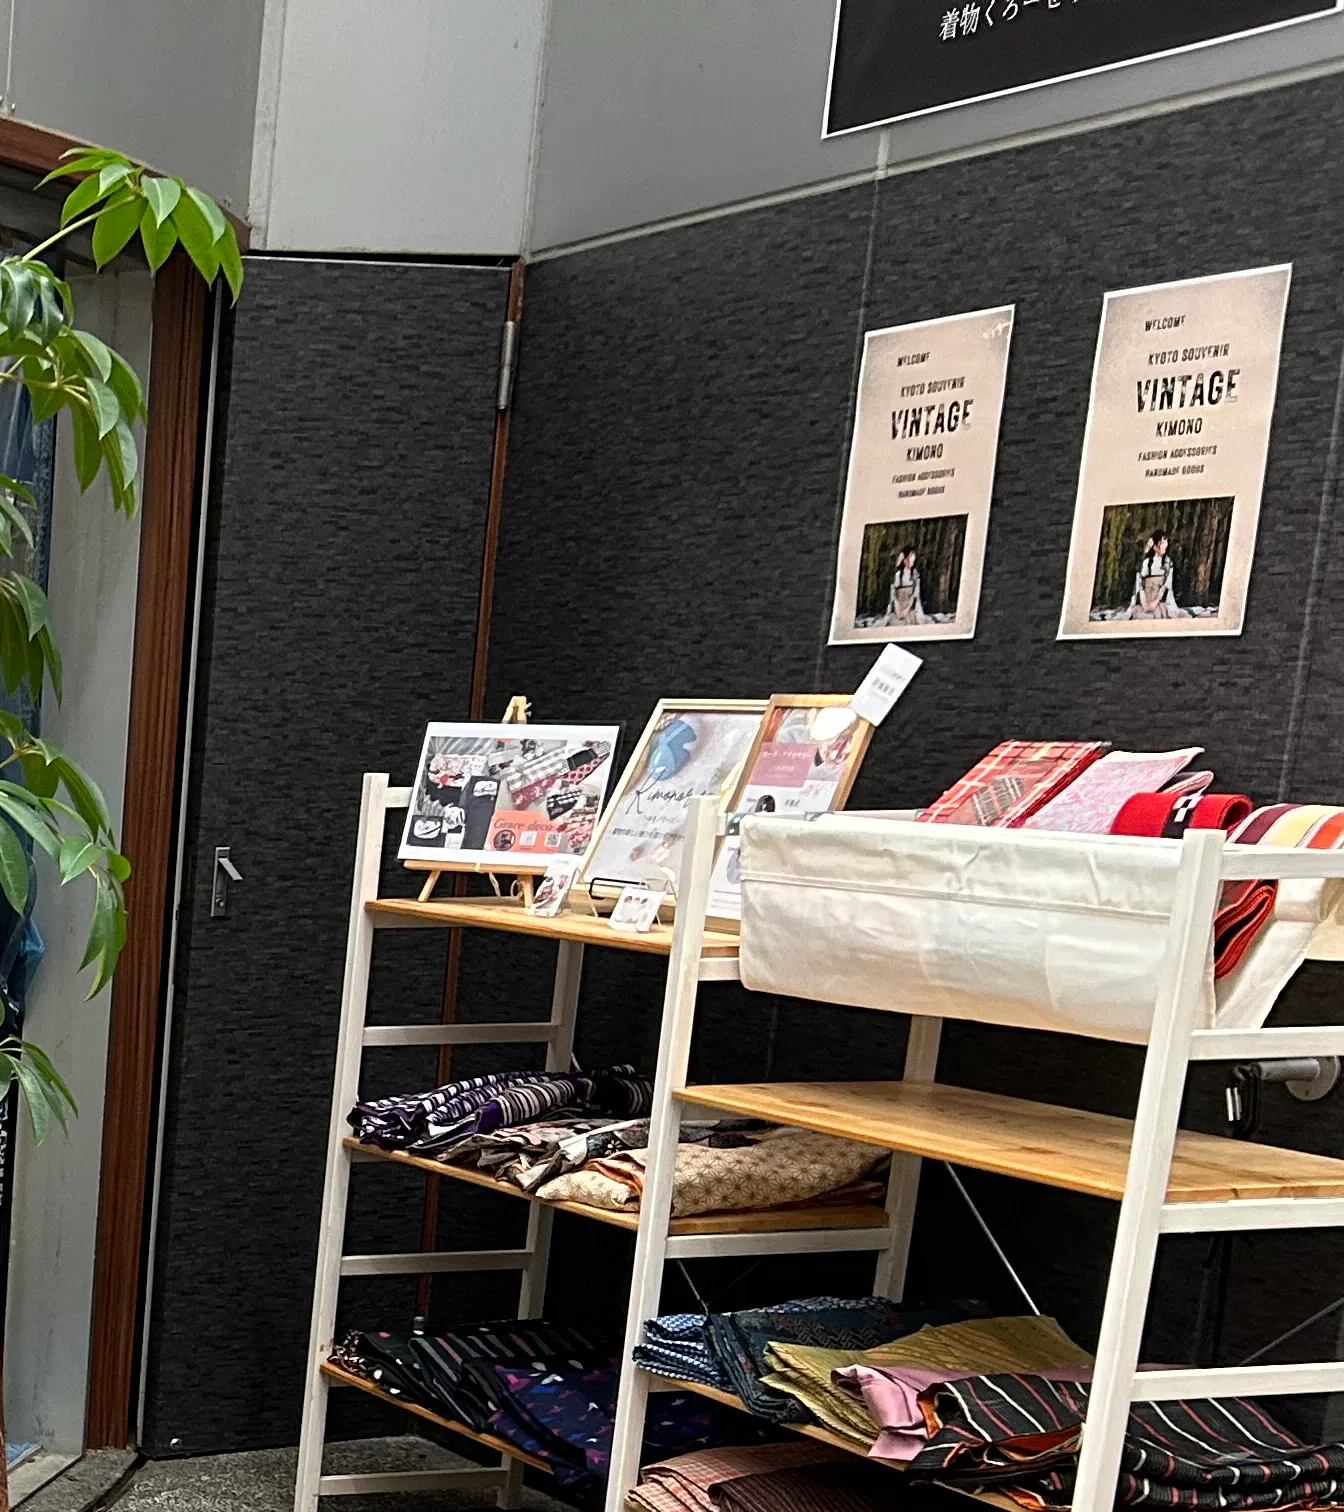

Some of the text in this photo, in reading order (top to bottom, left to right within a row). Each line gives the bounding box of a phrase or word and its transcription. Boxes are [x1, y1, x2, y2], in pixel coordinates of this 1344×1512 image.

[1145, 314, 1186, 332] WELCOME
[897, 351, 930, 368] WELCOME
[1148, 343, 1230, 366] KYOTO SOUVENIR
[901, 376, 965, 398] KYOTO SOUVENIR
[1136, 368, 1241, 413] VINTAGE
[891, 399, 974, 440] VINTAGE
[1155, 417, 1203, 438] KIMONO
[906, 443, 944, 462] KIMONO
[1138, 449, 1168, 462] FASHION
